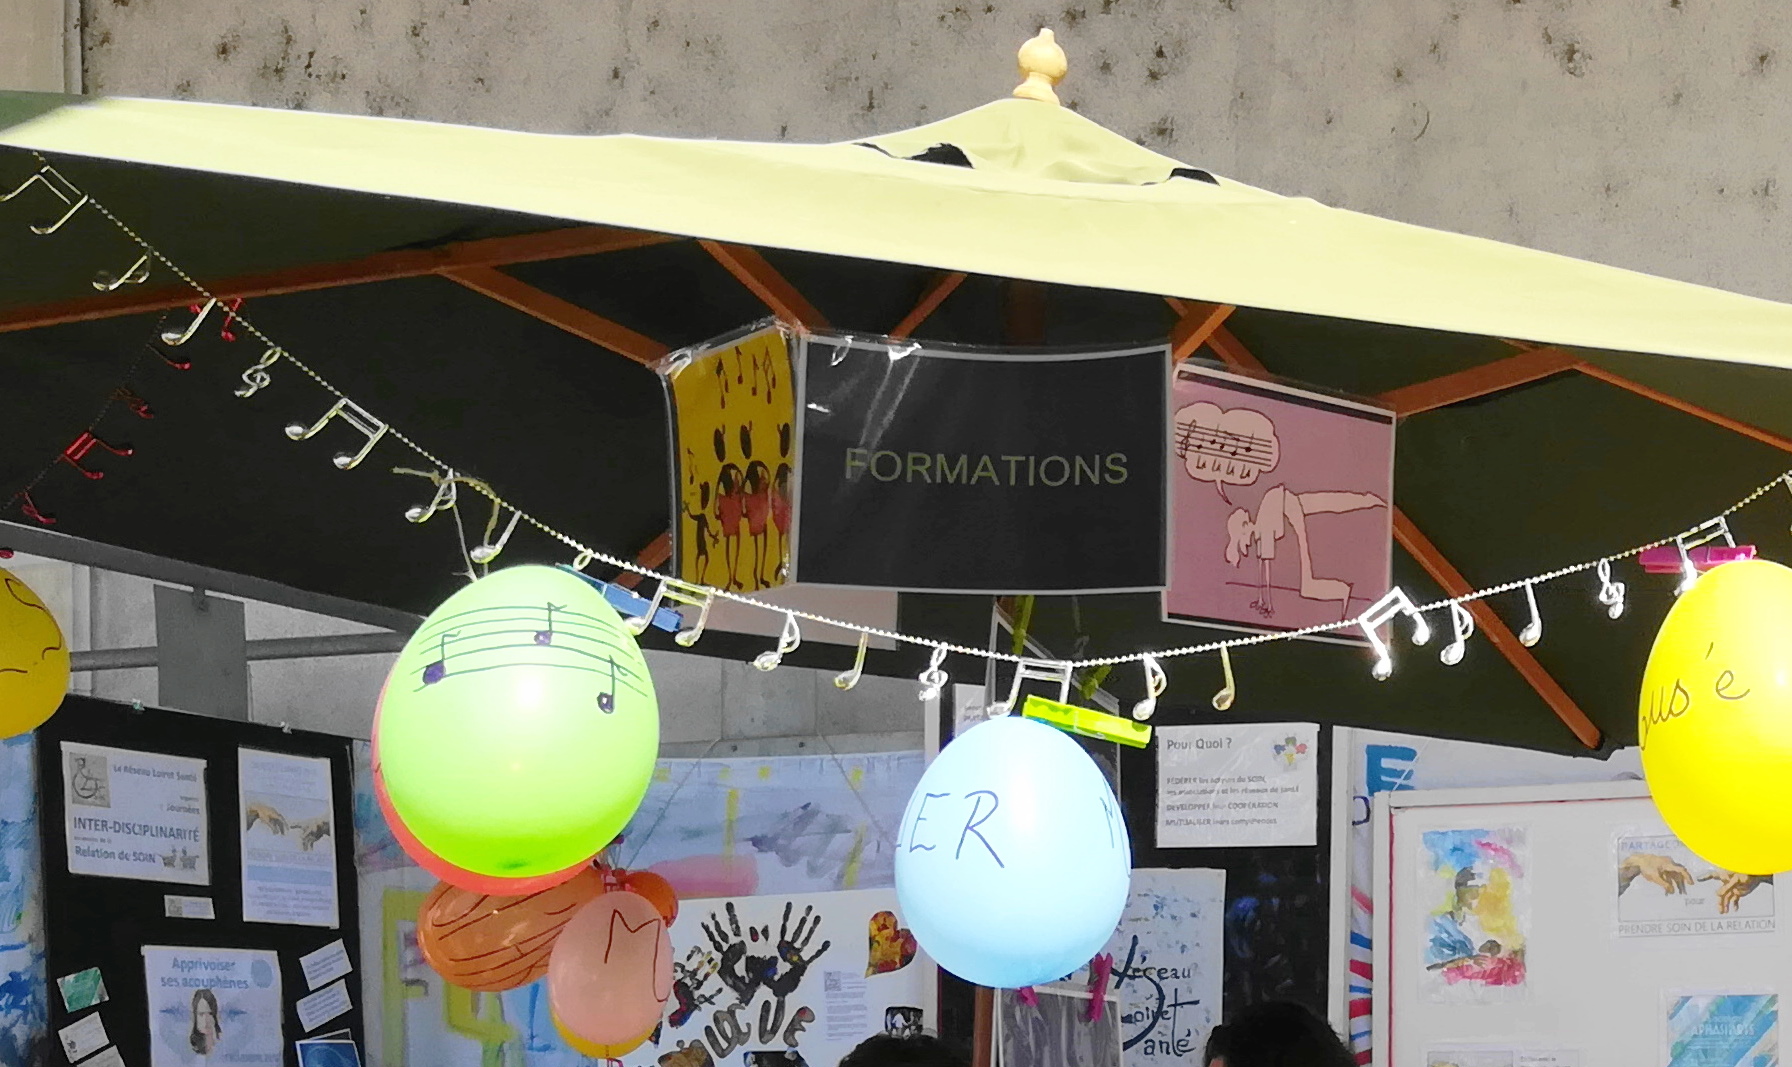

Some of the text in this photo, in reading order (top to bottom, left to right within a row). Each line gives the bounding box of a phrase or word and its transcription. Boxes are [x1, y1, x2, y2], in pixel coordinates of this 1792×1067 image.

[845, 447, 1129, 487] FORMATIONS
[1167, 739, 1191, 750] Pour
[1195, 738, 1223, 750] Quoi
[75, 846, 116, 861] Relation
[1618, 919, 1775, 934] PRENDRE SOIN DE LA RELATION
